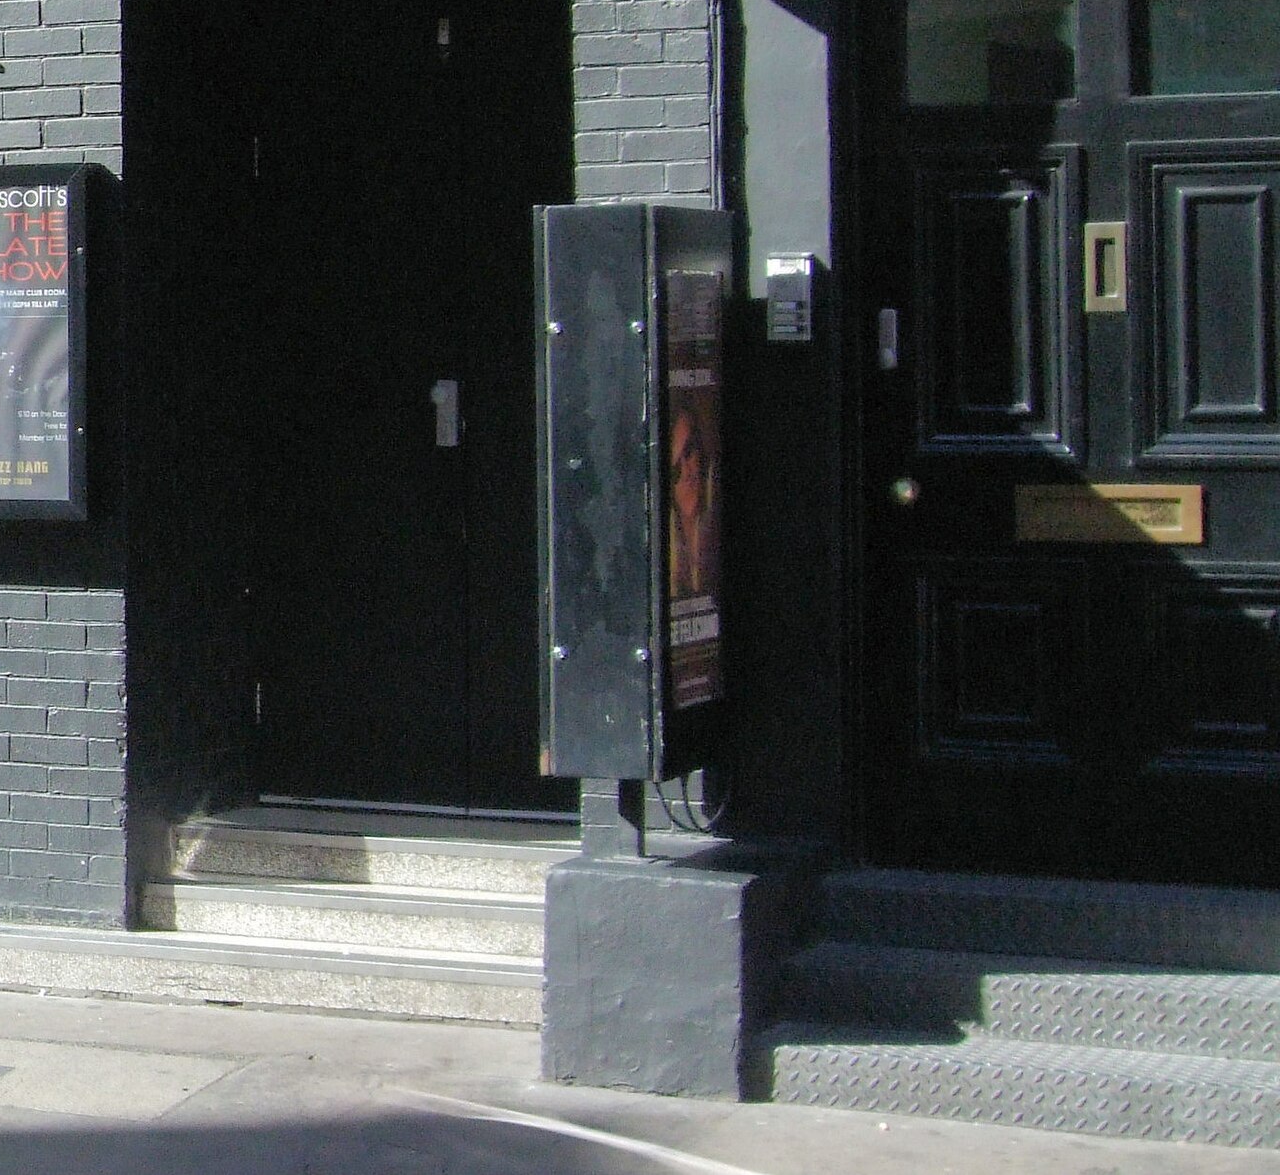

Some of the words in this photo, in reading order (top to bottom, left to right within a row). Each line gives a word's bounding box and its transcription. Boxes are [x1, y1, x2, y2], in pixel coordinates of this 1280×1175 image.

[3, 211, 66, 233] THE
[26, 288, 43, 296] CLUB
[44, 300, 59, 308] LATE
